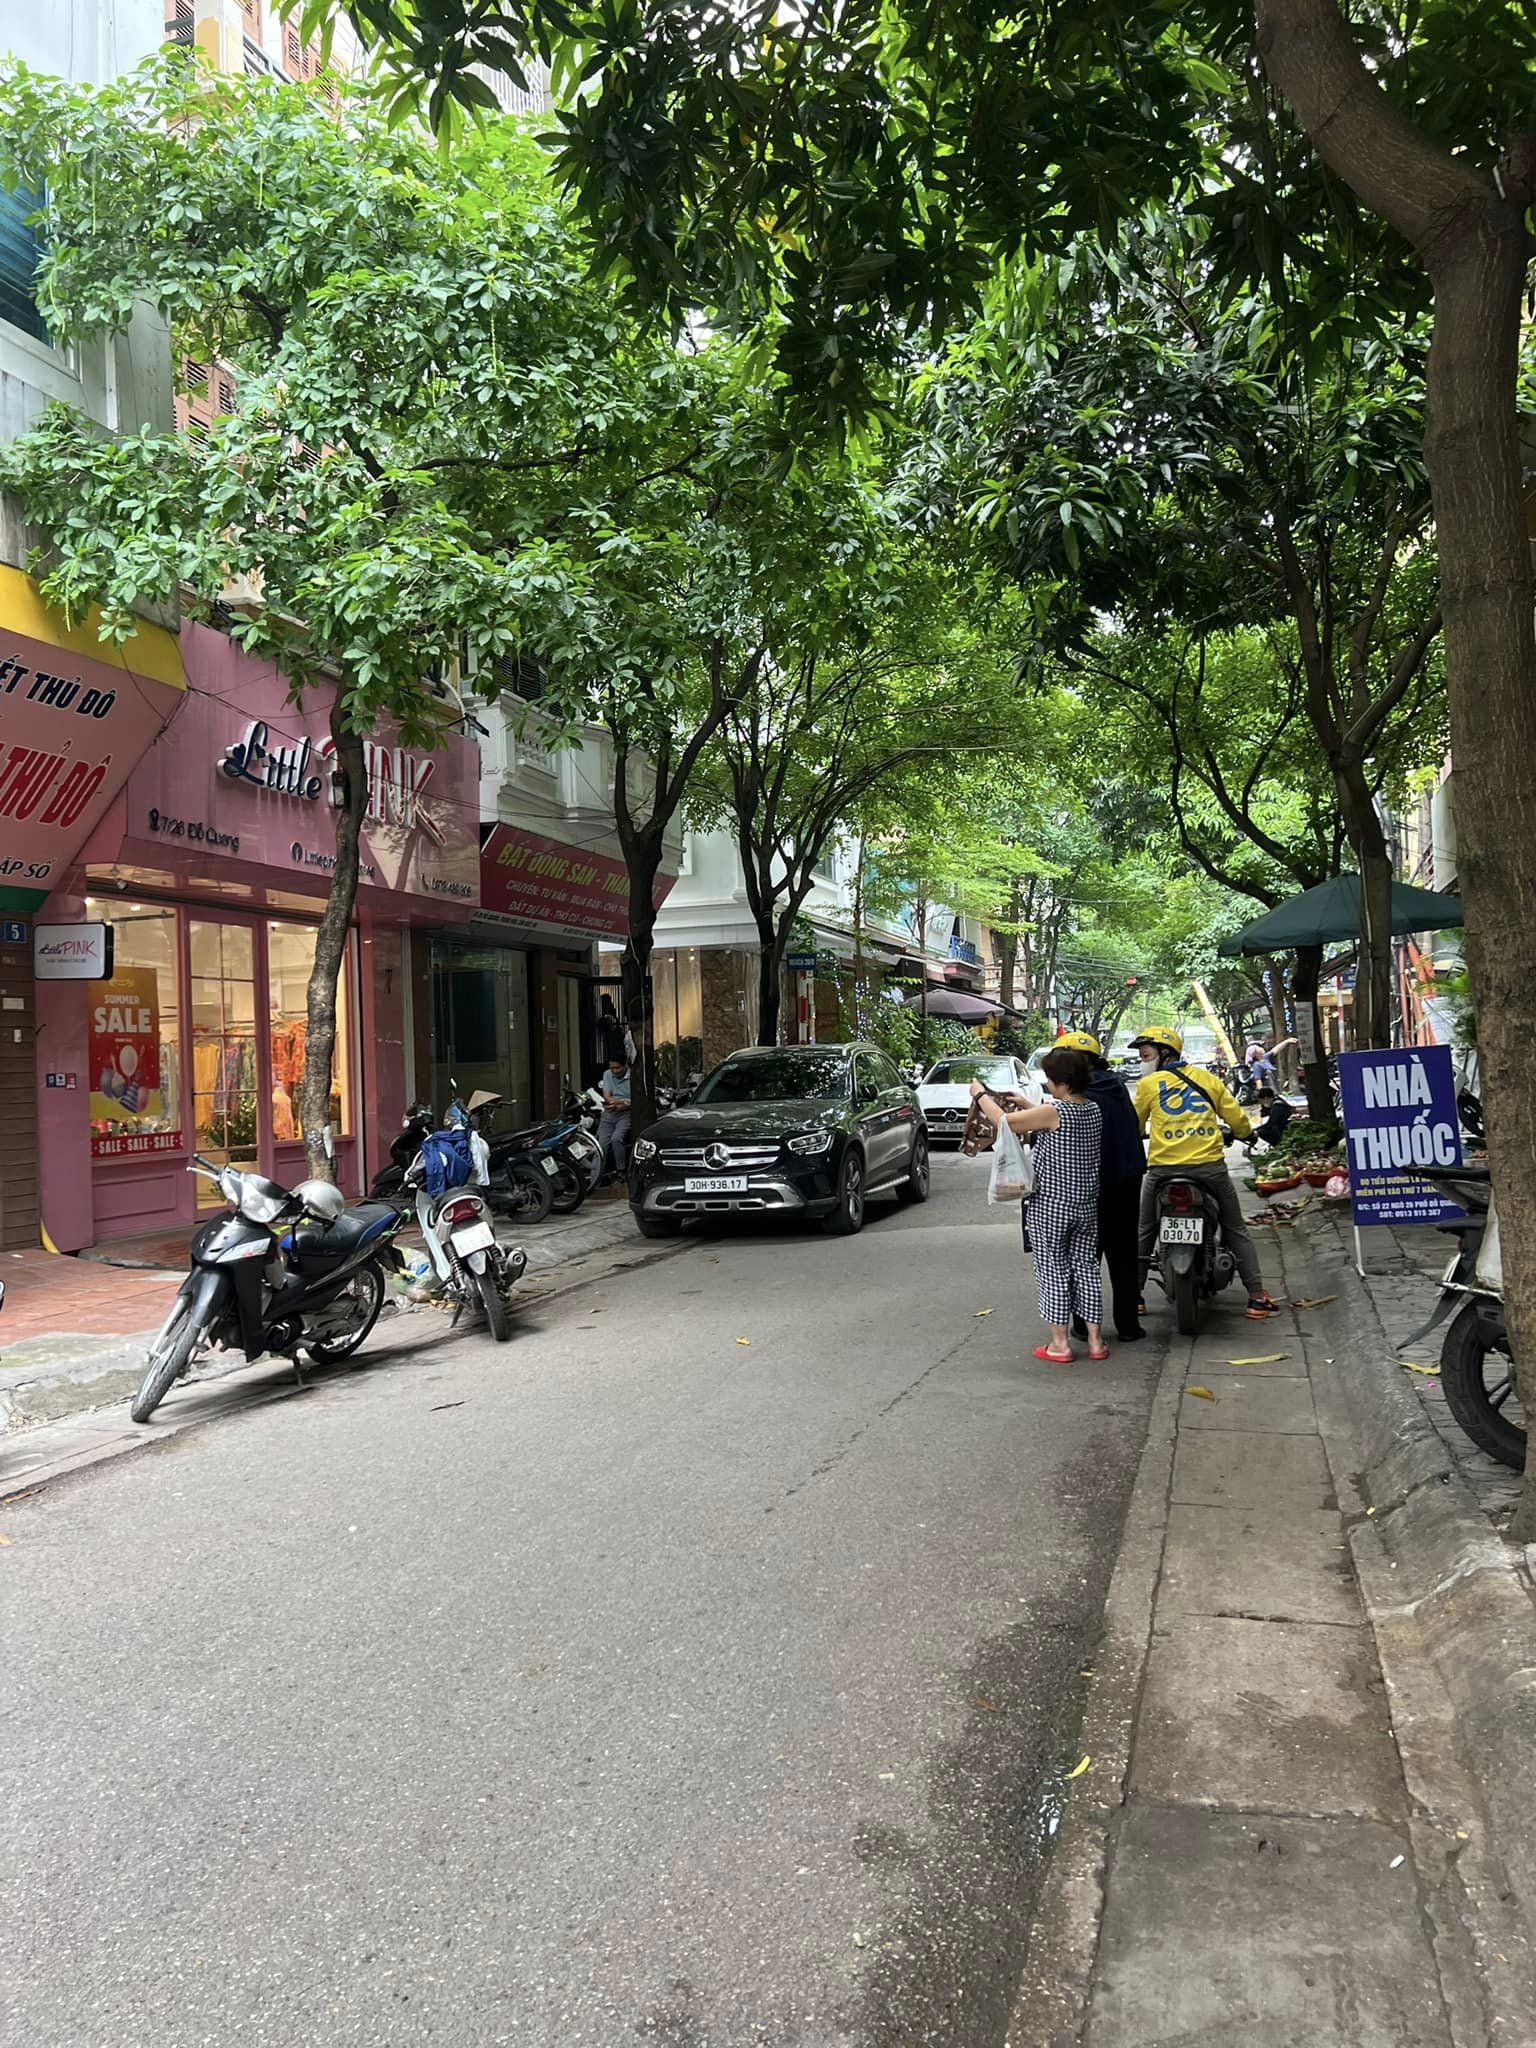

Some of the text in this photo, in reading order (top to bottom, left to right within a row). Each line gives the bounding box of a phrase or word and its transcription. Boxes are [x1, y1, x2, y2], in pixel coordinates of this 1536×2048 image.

[26, 672, 81, 709] THỦ
[76, 689, 116, 719] ĐÔ
[39, 754, 111, 828] ĐÔ
[11, 925, 19, 940] 5
[62, 941, 97, 957] PINK
[104, 994, 140, 1005] SUMMER
[94, 1007, 152, 1033] SALE
[1362, 1054, 1433, 1109] NHÀ
[99, 1140, 121, 1154] SALE
[127, 1138, 149, 1151] SALE
[154, 1135, 175, 1149] SALE
[1349, 1109, 1456, 1171] THUỐC
[1167, 1219, 1196, 1230] 36-L1
[1163, 1230, 1200, 1242] 030.70
